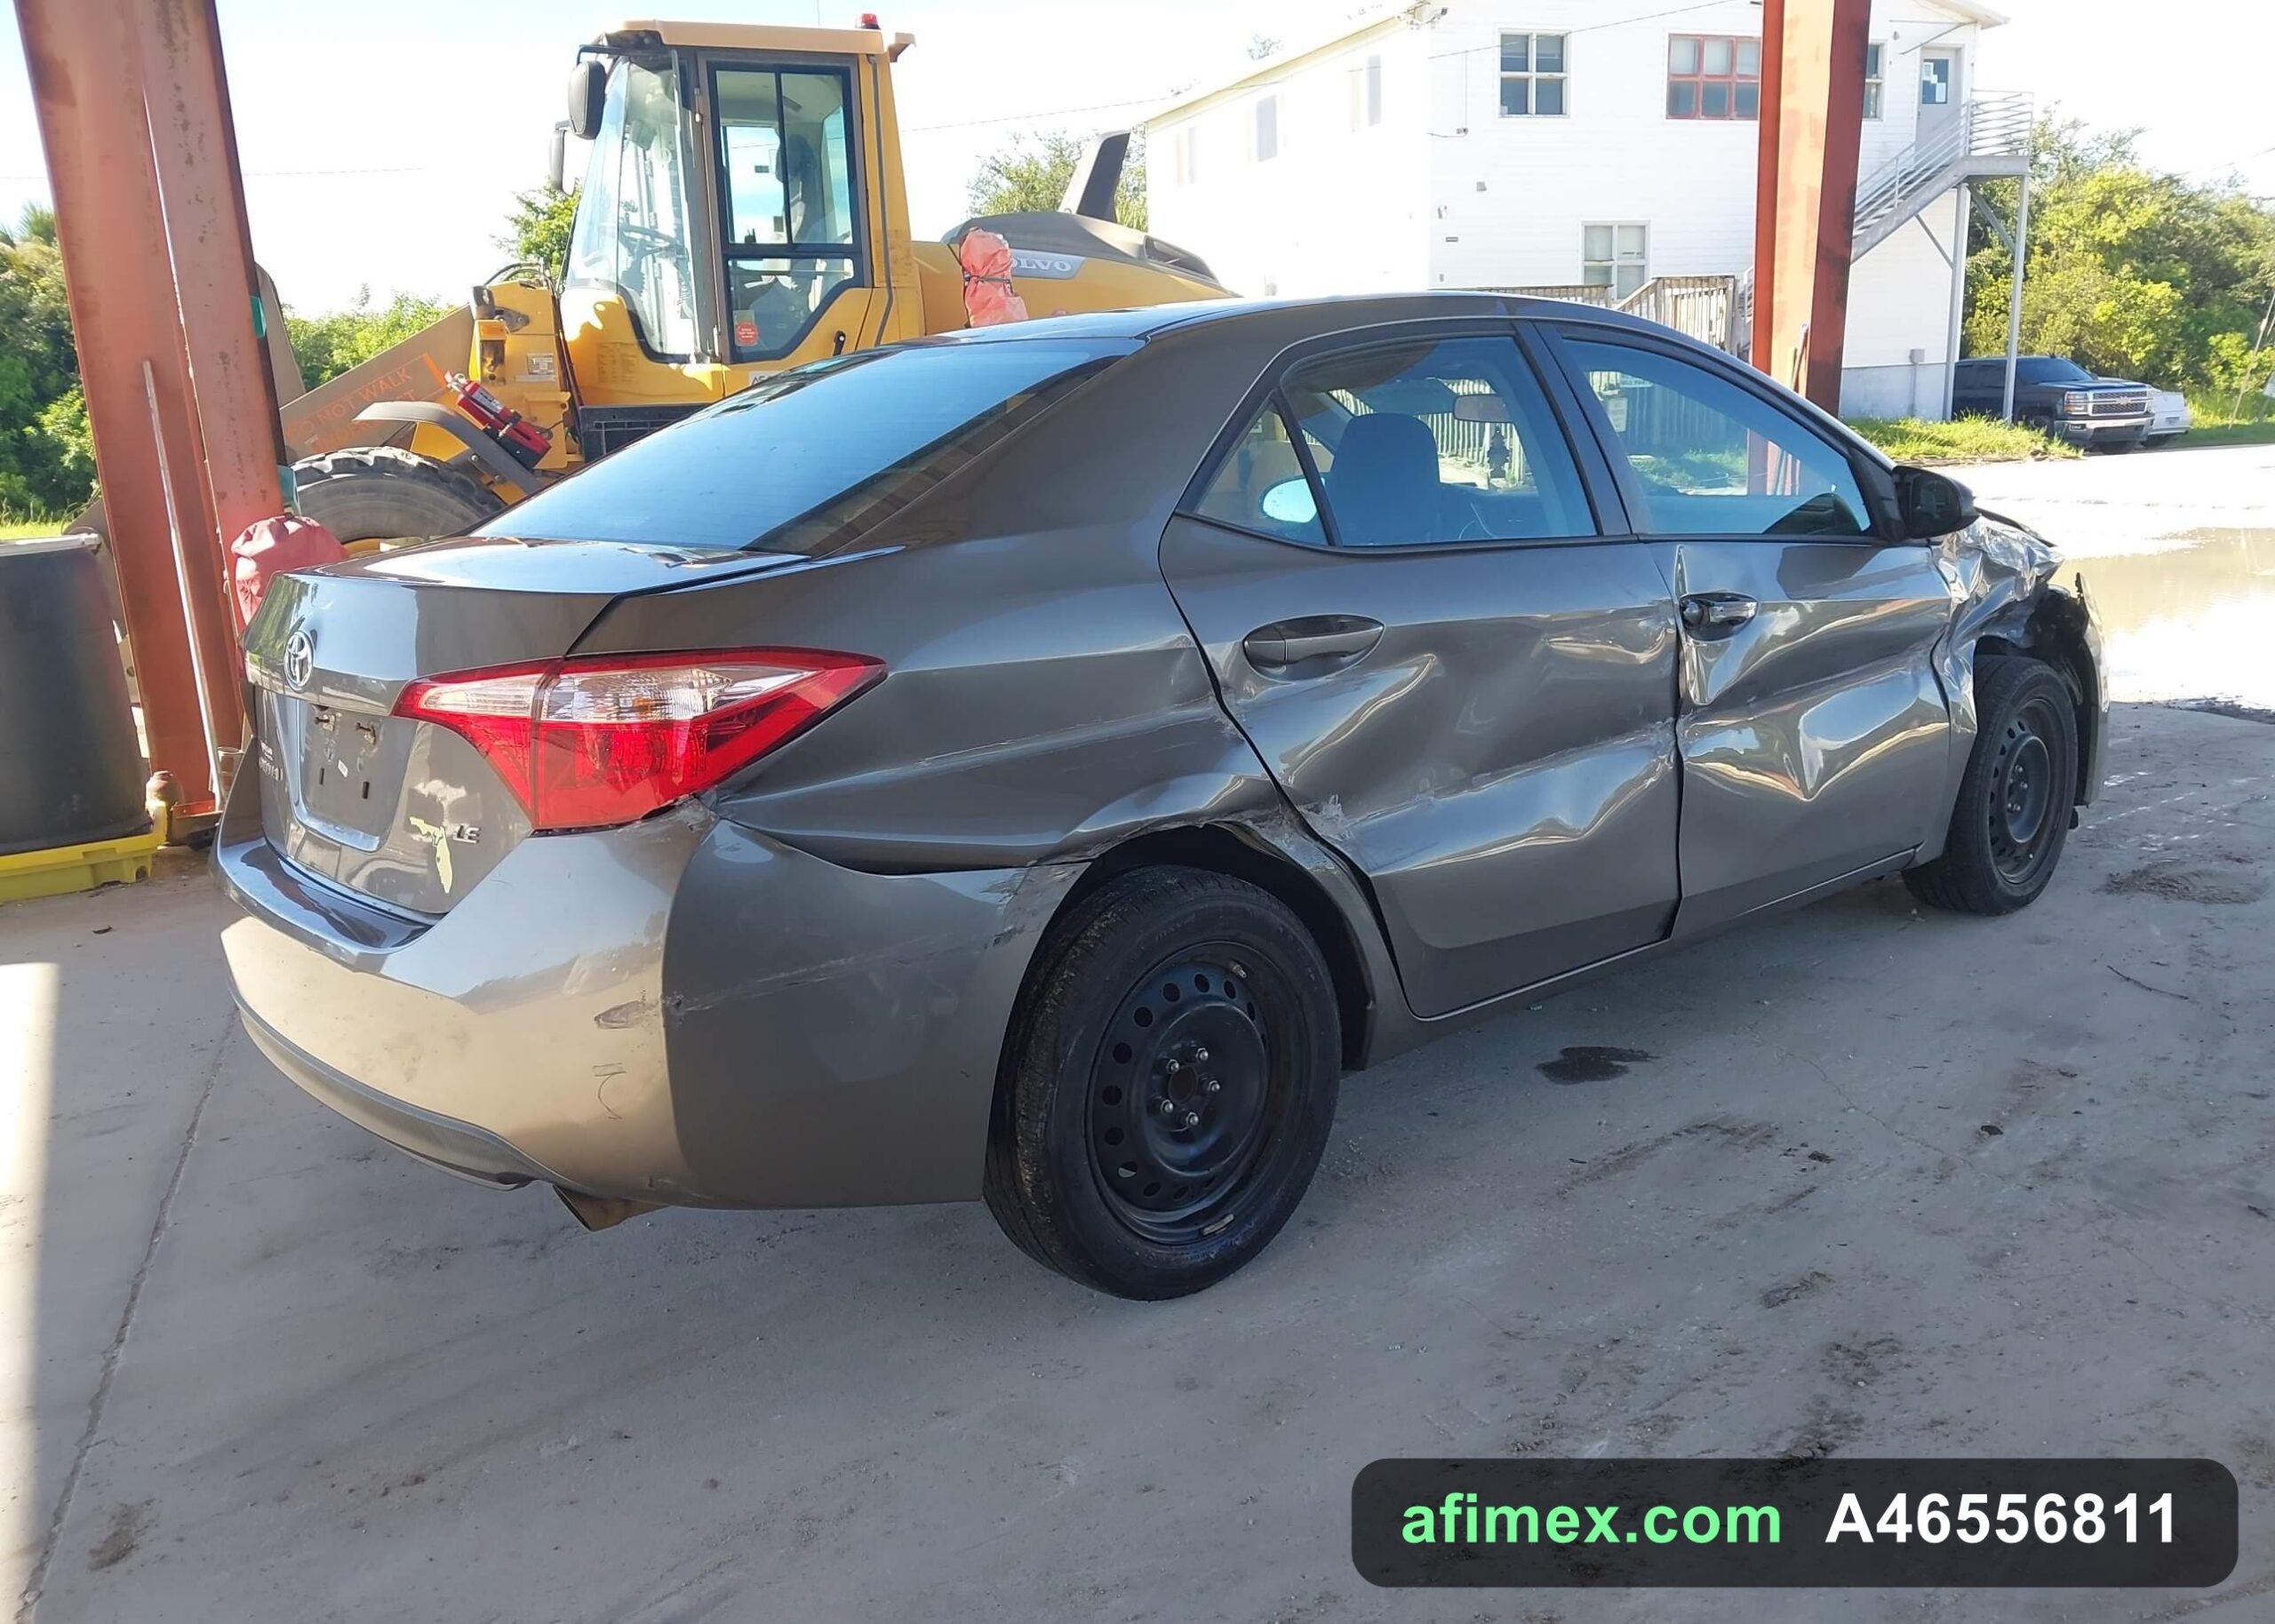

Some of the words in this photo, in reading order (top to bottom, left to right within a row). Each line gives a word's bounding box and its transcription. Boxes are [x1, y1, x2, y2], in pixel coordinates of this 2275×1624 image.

[1011, 256, 1072, 272] LVO
[315, 396, 357, 426] NOT
[358, 367, 413, 402] WALK
[452, 824, 481, 844] LE
